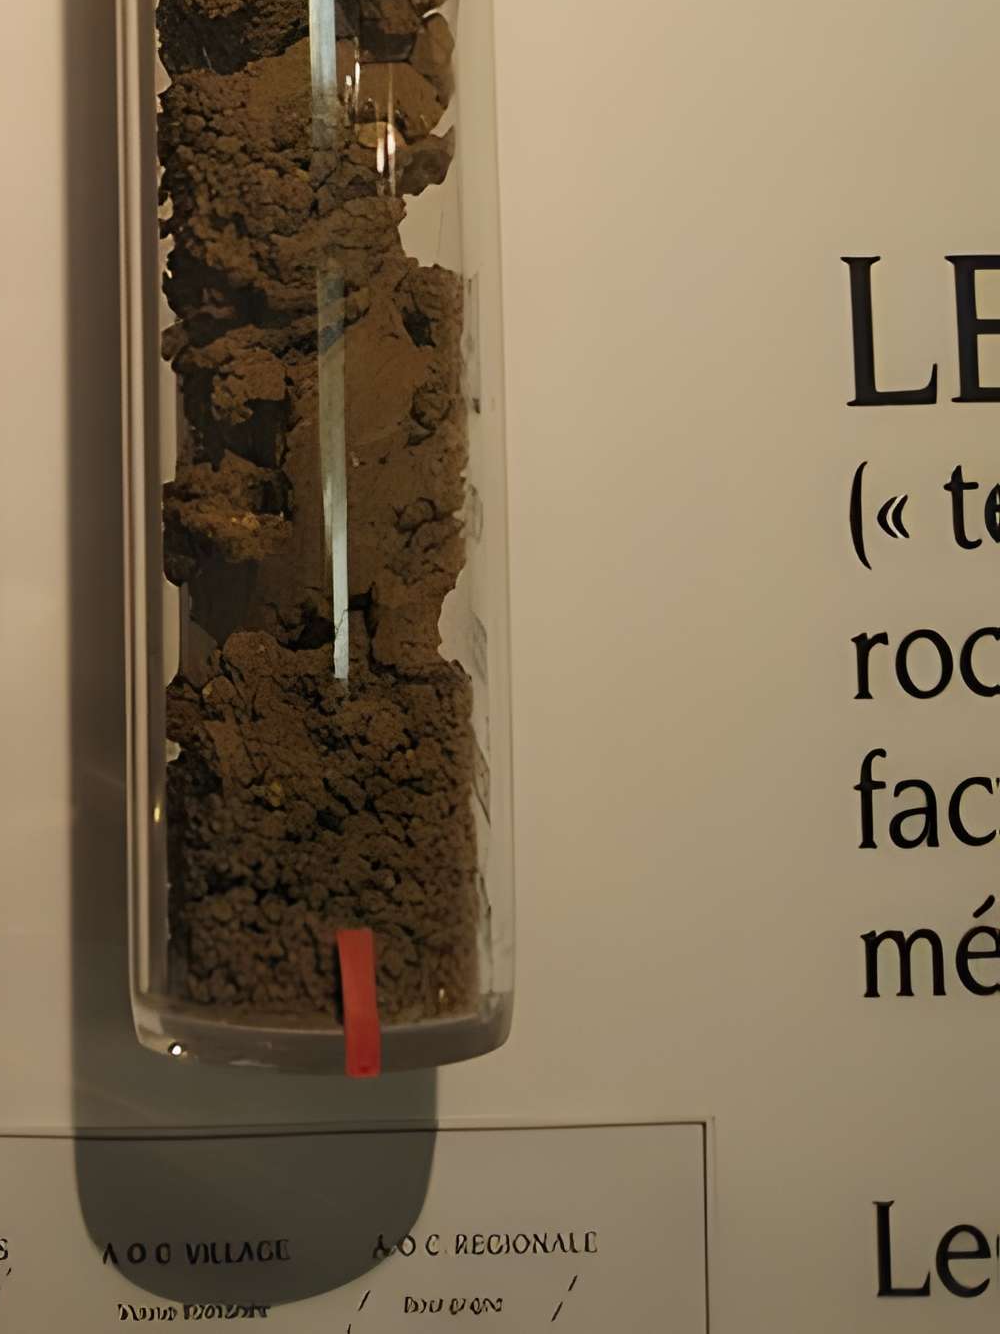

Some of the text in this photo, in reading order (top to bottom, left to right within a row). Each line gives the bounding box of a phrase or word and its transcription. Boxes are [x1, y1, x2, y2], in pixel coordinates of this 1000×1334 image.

[840, 255, 1000, 407] LE
[850, 626, 1000, 700] roc
[853, 748, 1000, 849] fac
[871, 1200, 1000, 1298] Le
